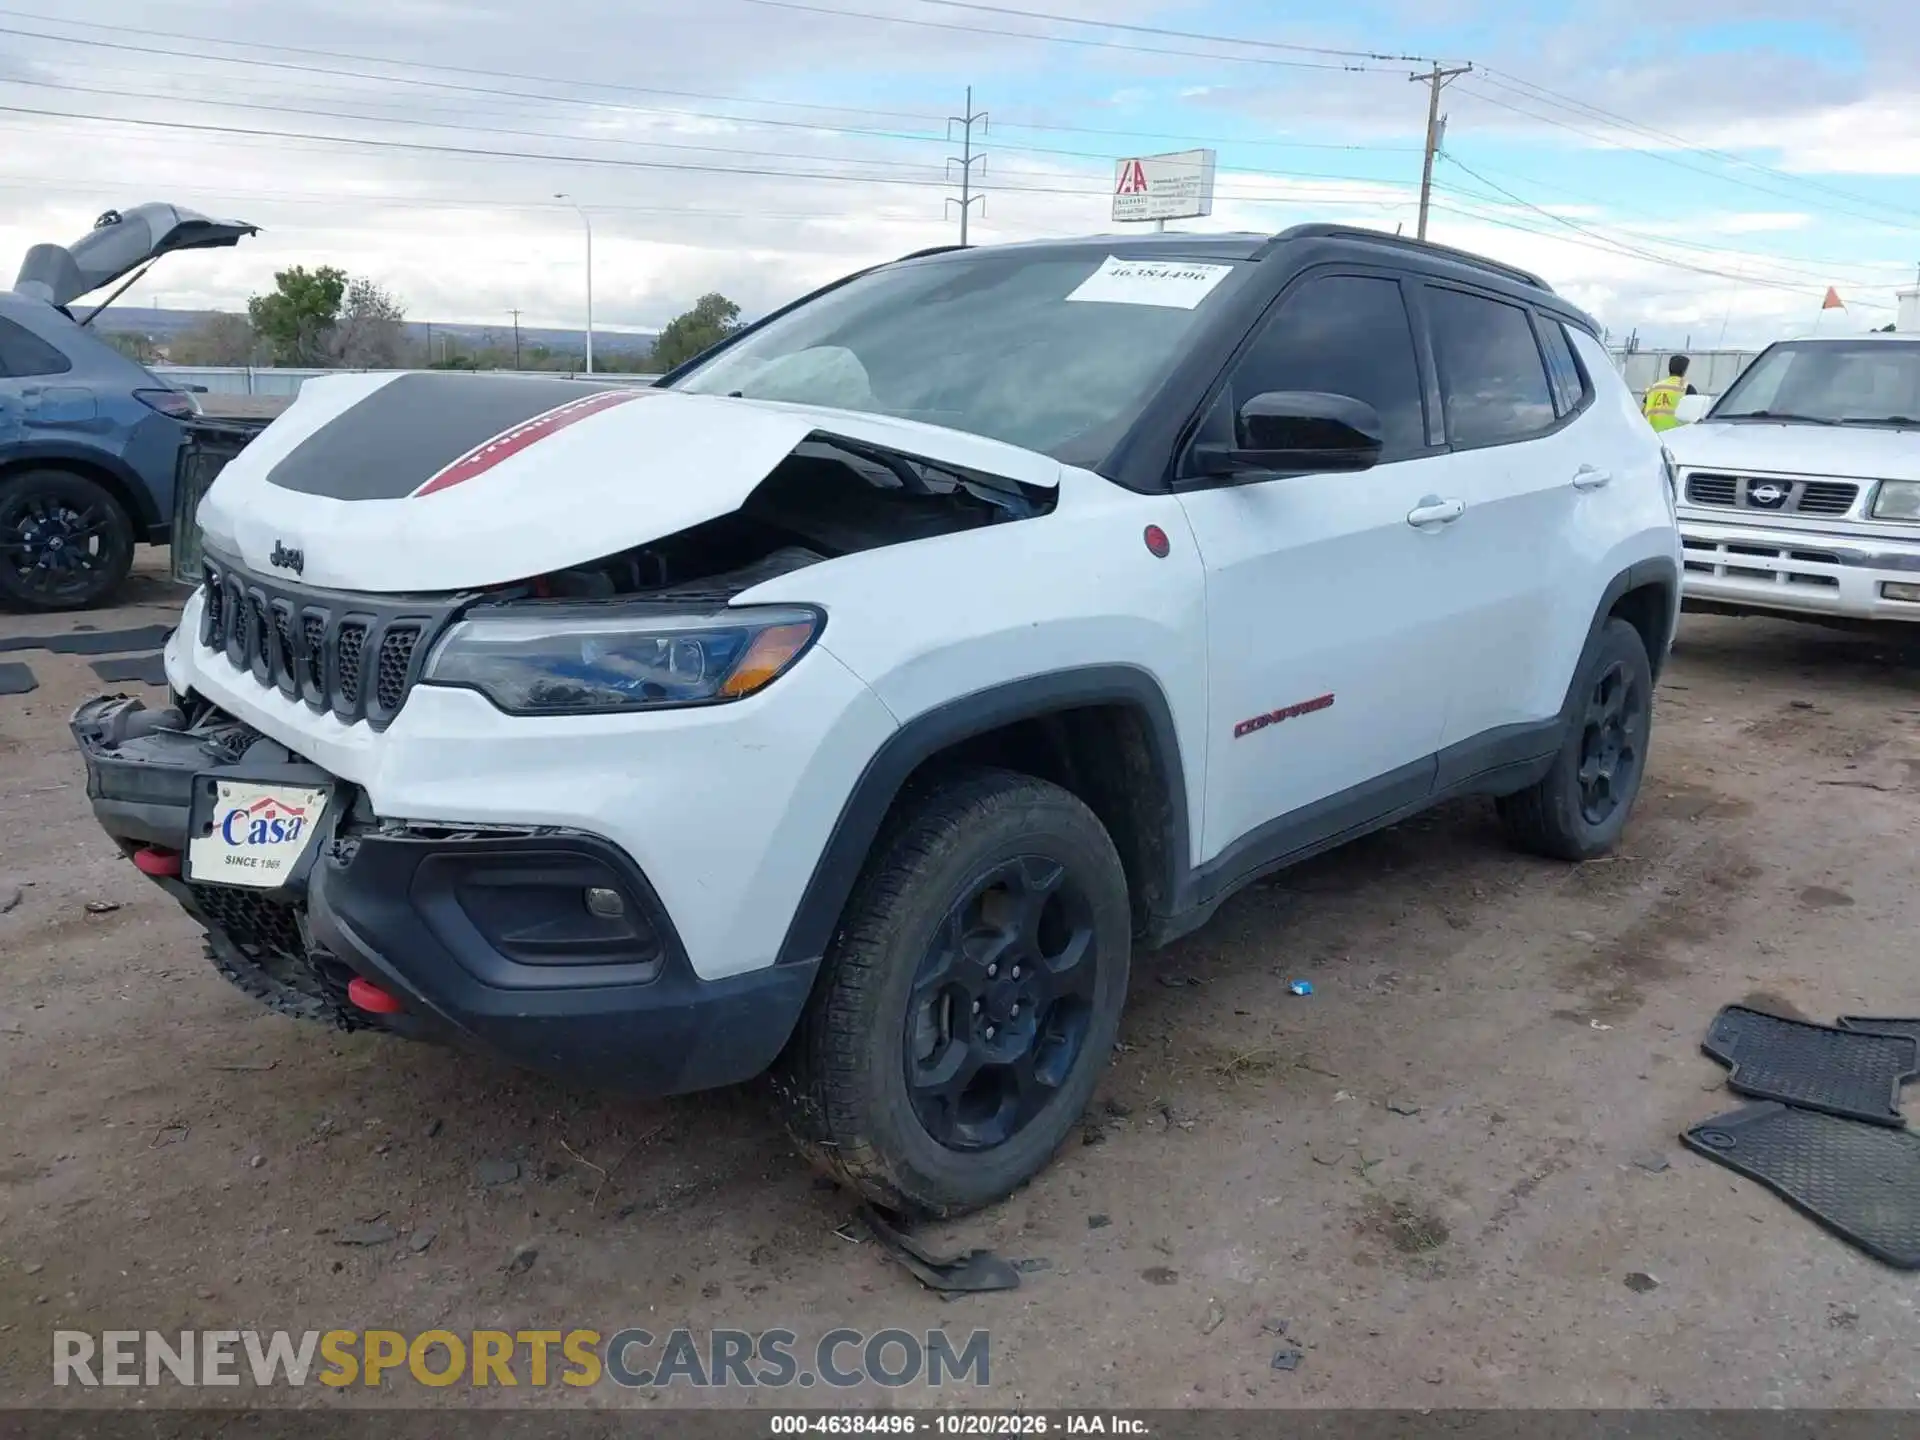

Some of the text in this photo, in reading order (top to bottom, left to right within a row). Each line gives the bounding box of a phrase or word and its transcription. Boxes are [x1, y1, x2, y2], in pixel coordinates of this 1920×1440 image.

[270, 539, 304, 576] Jeep
[222, 809, 301, 846] Casa
[224, 854, 257, 868] SINCE
